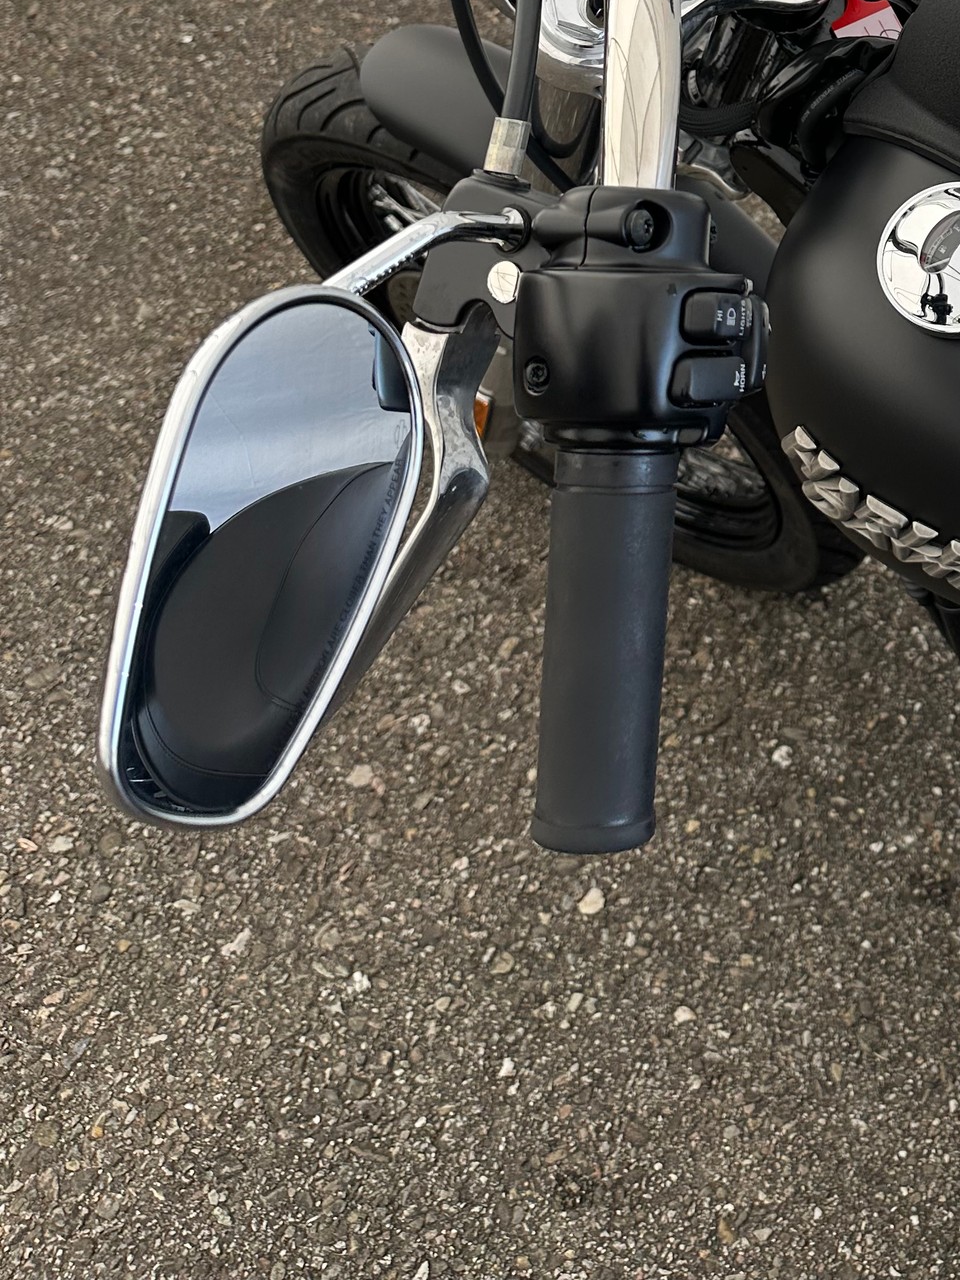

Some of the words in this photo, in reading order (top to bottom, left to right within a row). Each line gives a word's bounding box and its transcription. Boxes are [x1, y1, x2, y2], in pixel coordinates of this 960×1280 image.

[717, 310, 723, 321] HI
[359, 541, 377, 578] THAN
[371, 508, 389, 542] THEY
[386, 457, 405, 508] APPEAR
